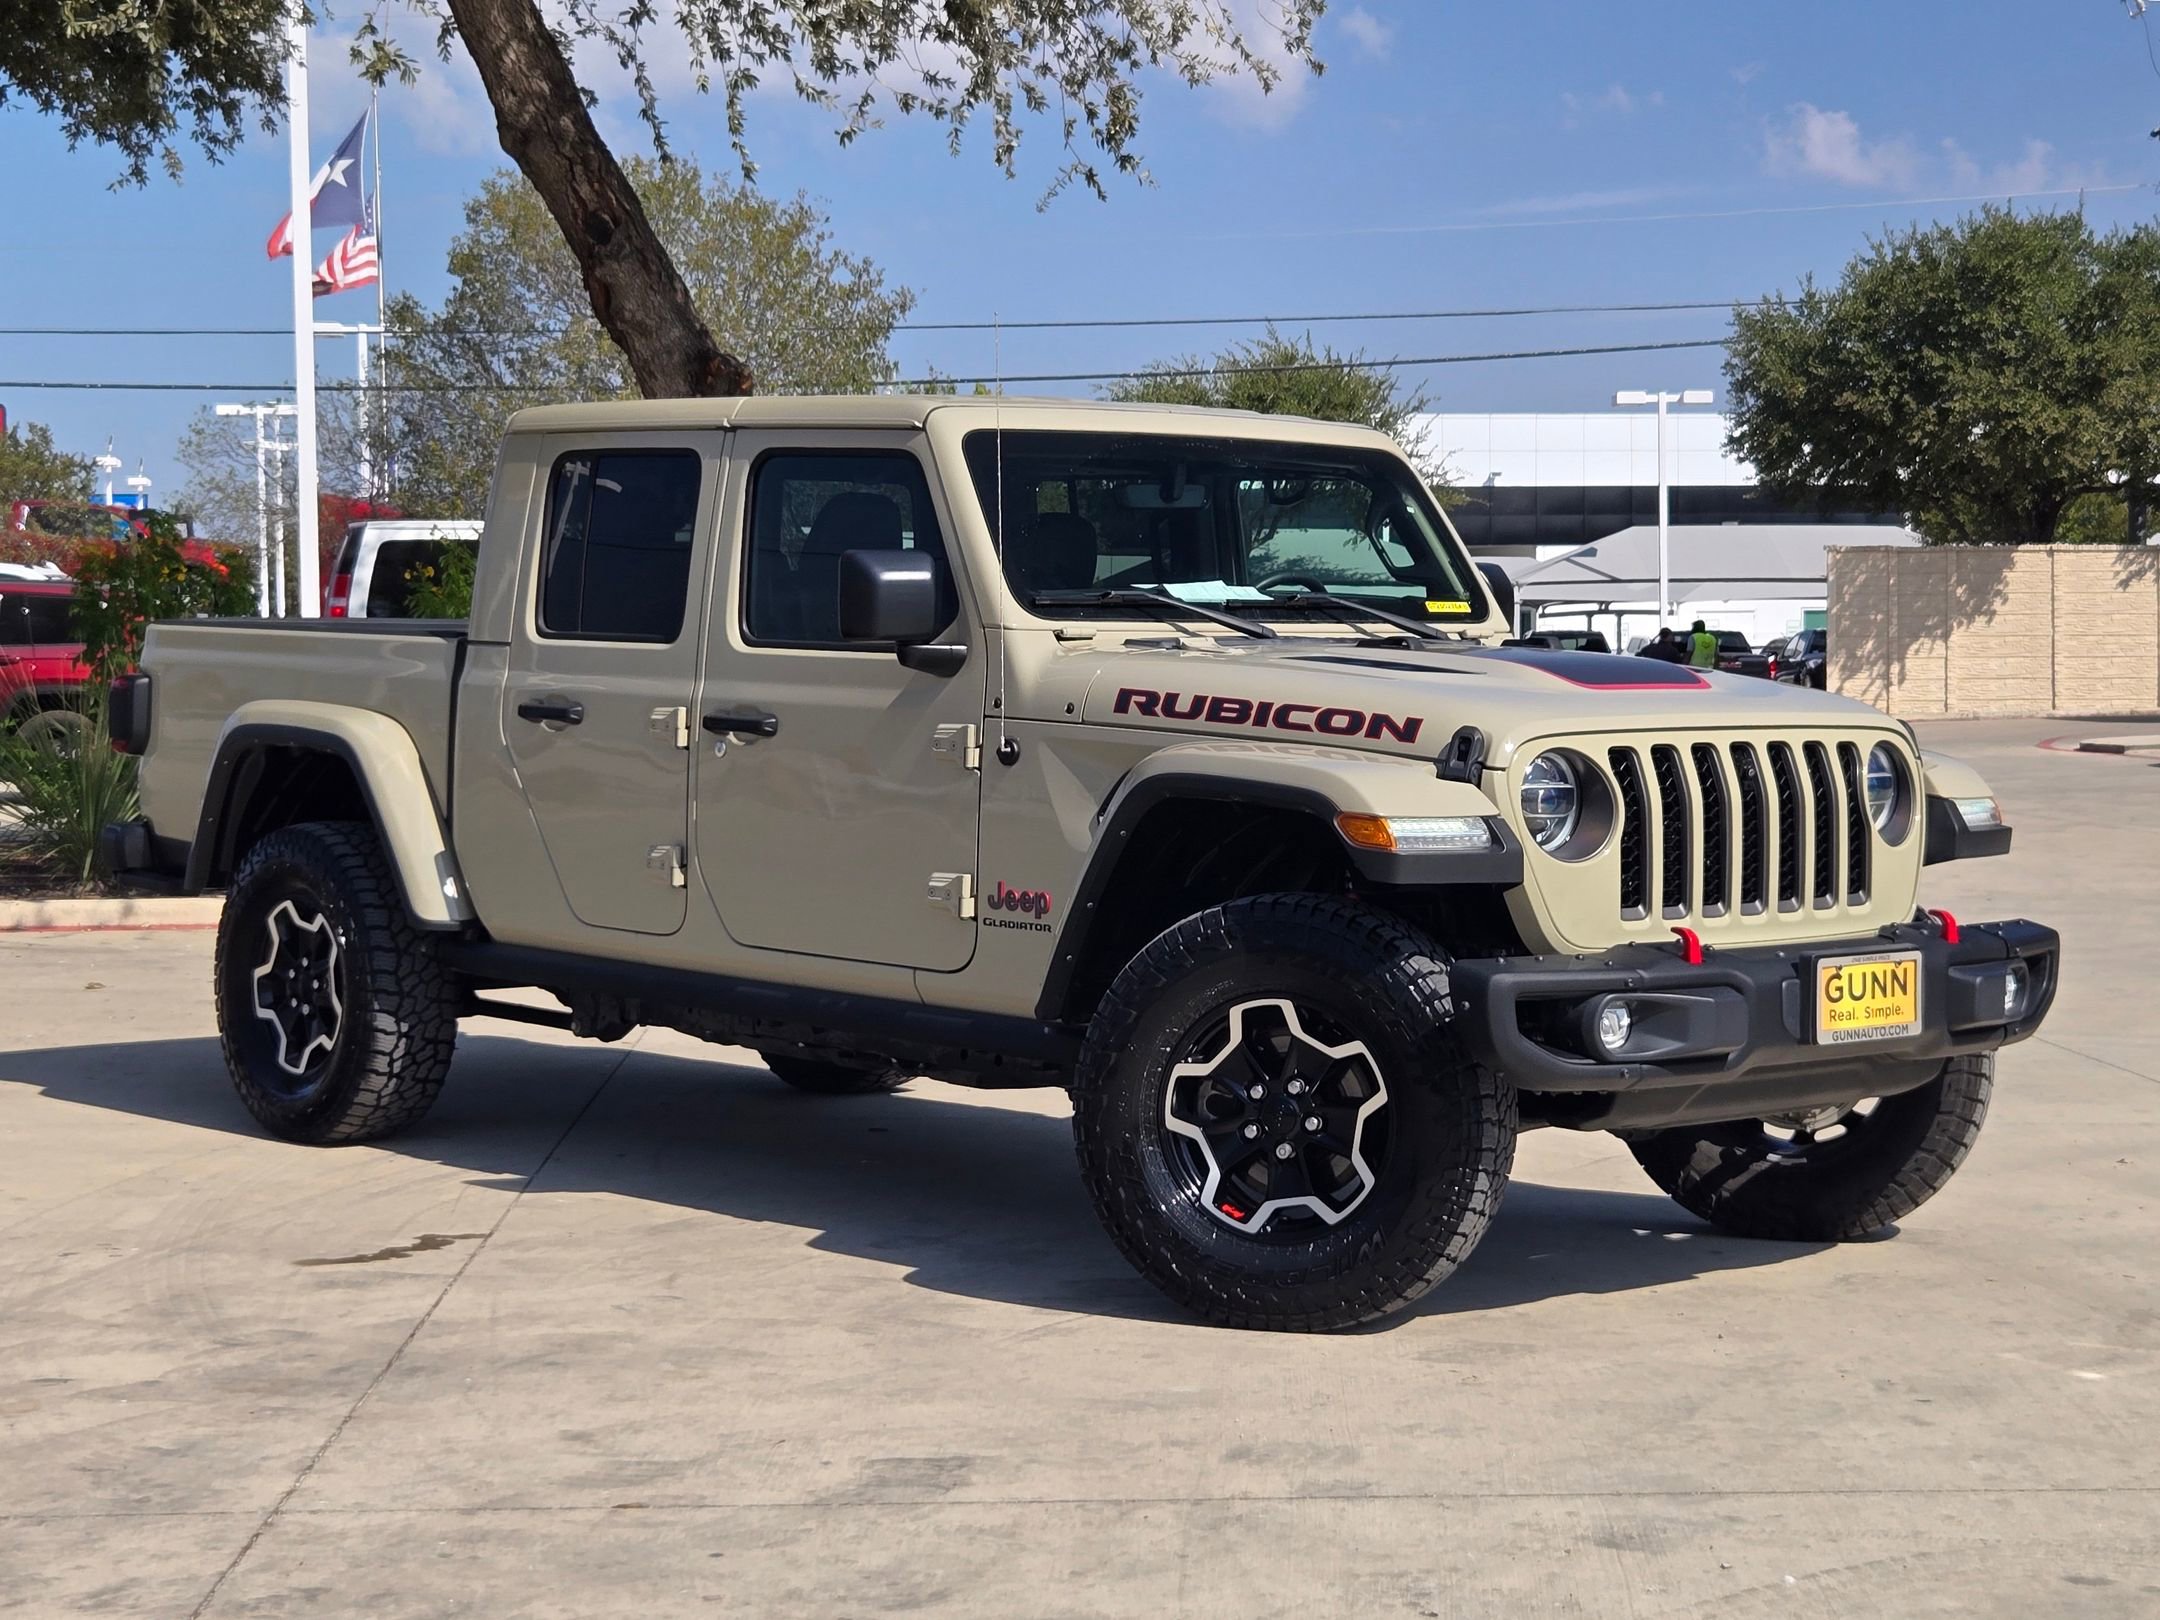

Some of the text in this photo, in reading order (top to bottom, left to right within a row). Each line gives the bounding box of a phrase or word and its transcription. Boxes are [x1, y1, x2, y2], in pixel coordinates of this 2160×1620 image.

[1113, 687, 1424, 744] RUBICON
[987, 880, 1053, 919] Jeep
[983, 917, 1052, 933] GLADIATOR
[1824, 967, 1908, 1003] GUNN
[1829, 1007, 1860, 1022] Real.
[1831, 1024, 1909, 1041] GUNNAUTO.COM
